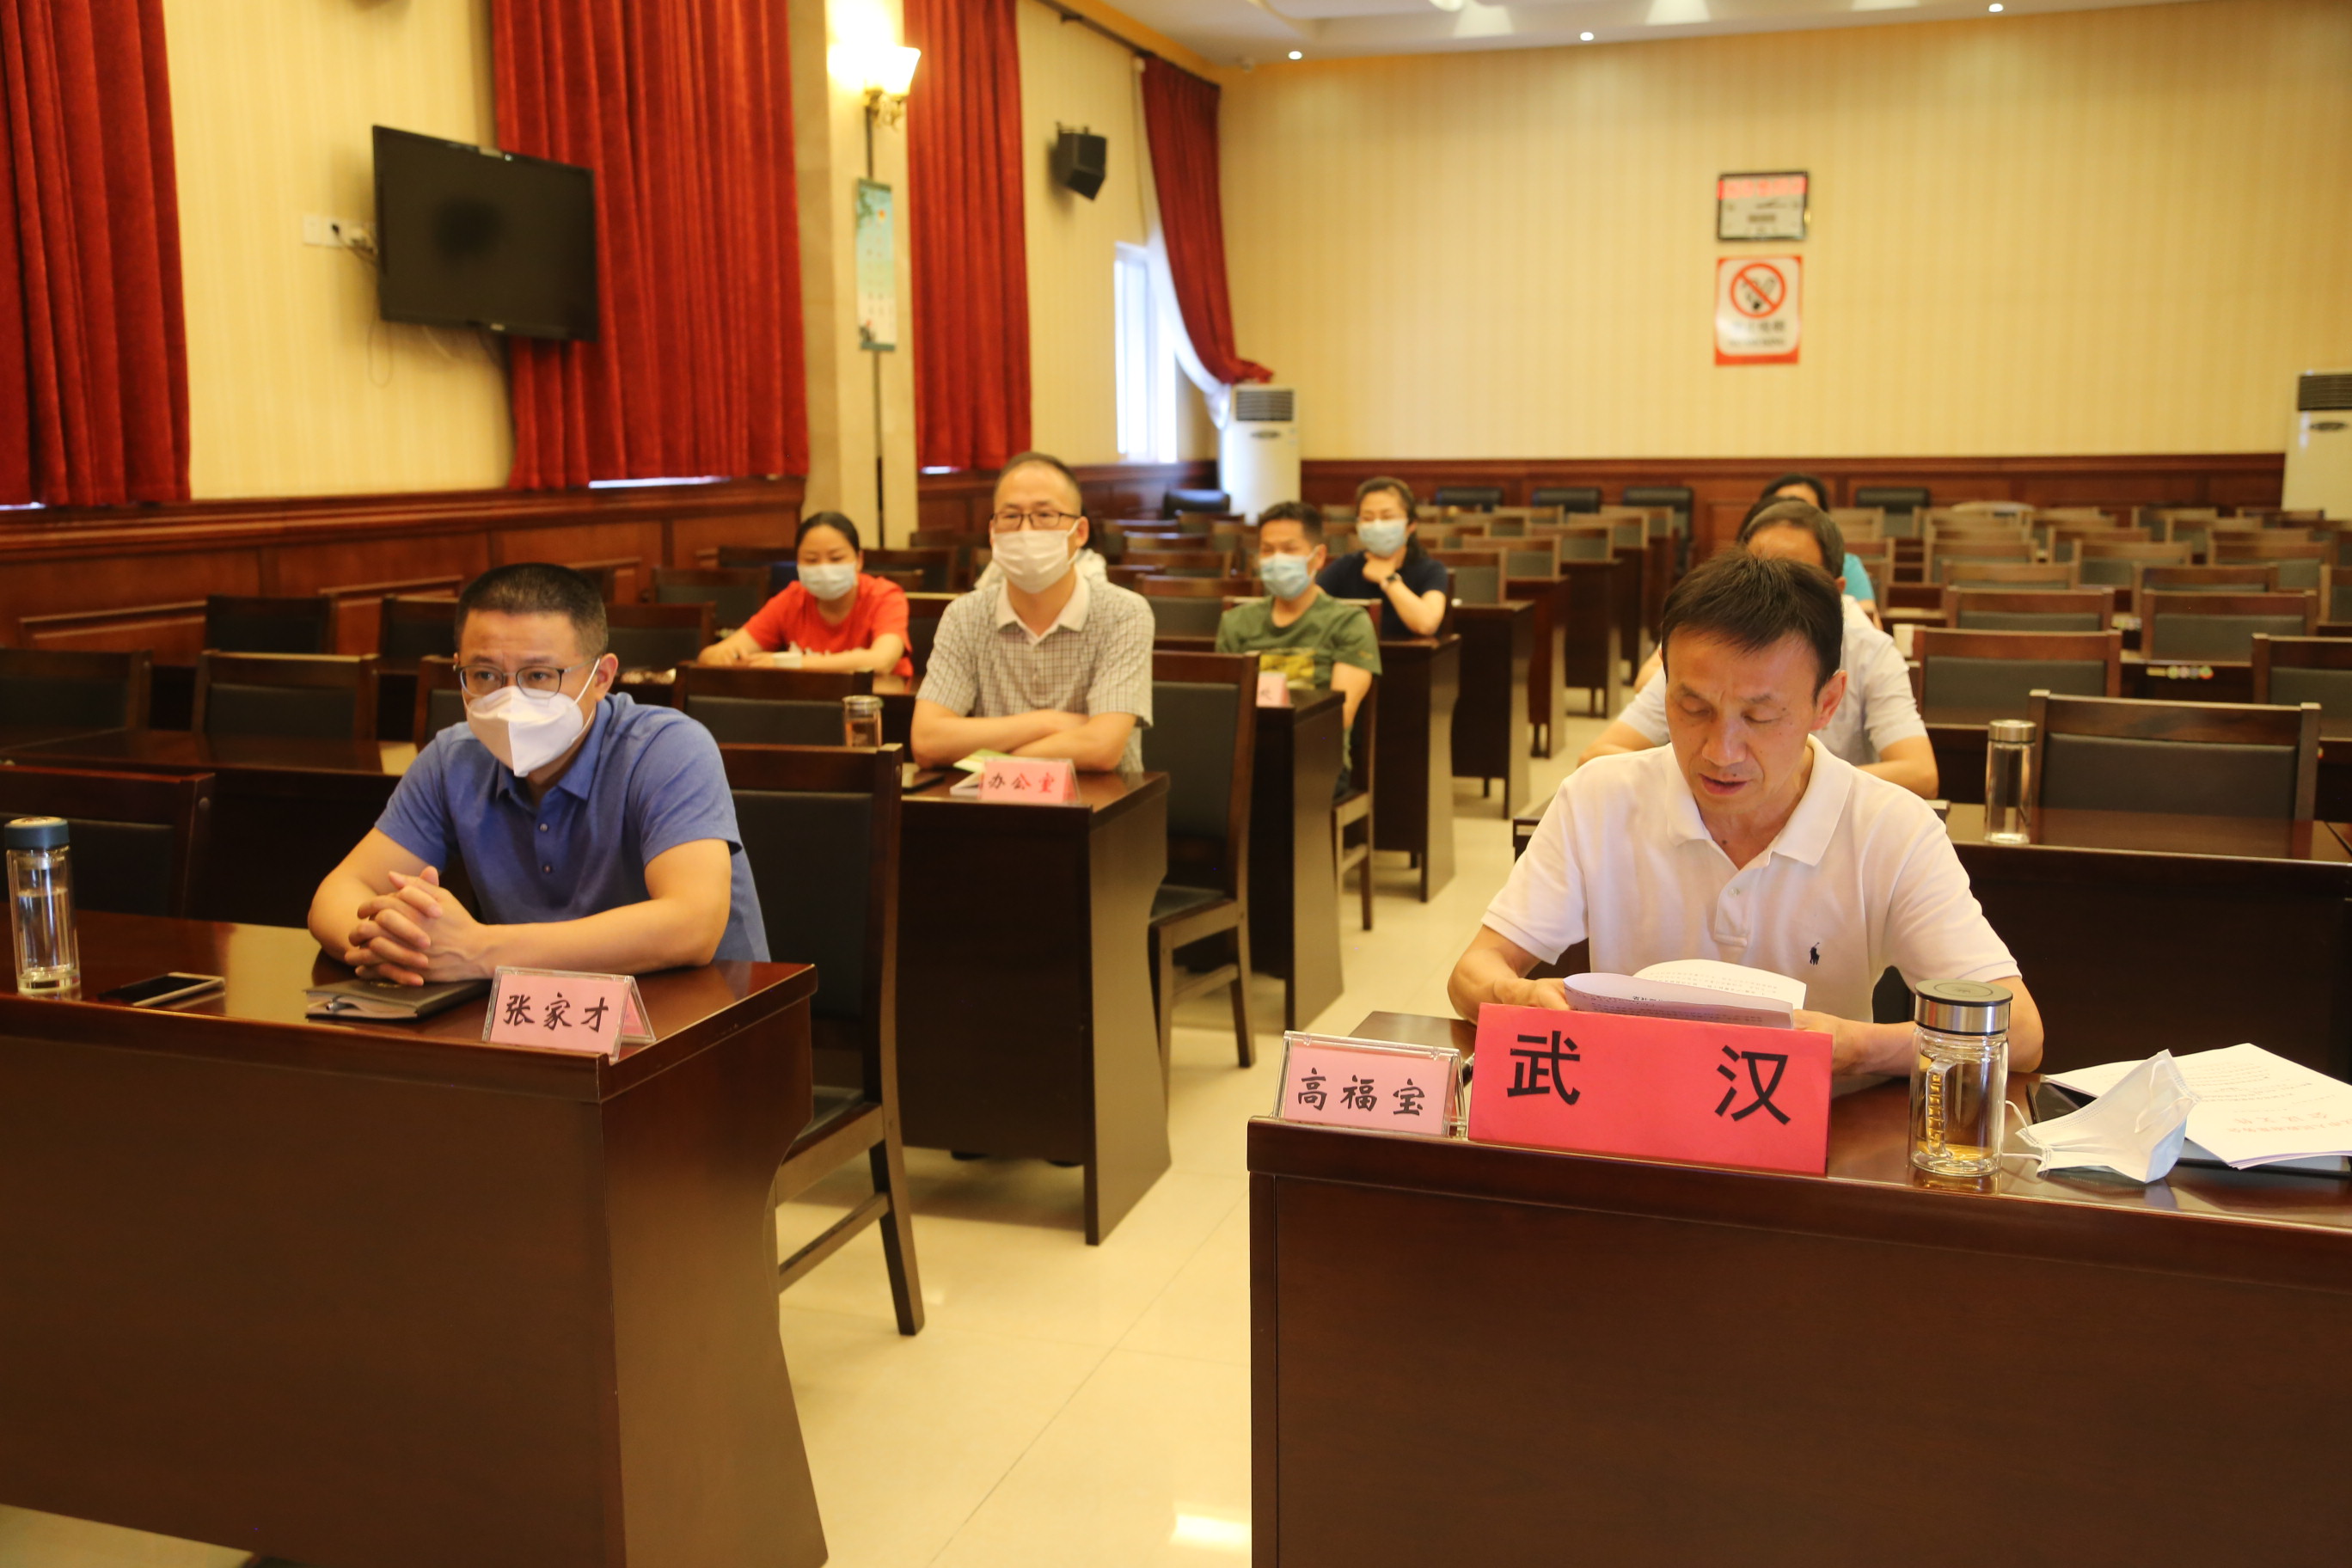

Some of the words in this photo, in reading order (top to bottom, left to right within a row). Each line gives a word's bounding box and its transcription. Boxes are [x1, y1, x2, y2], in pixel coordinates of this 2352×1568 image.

[988, 771, 1056, 793] 办公室
[502, 991, 609, 1033] 张家才
[1297, 1068, 1425, 1116] 高福宝
[1507, 1030, 1791, 1125] 武汉
